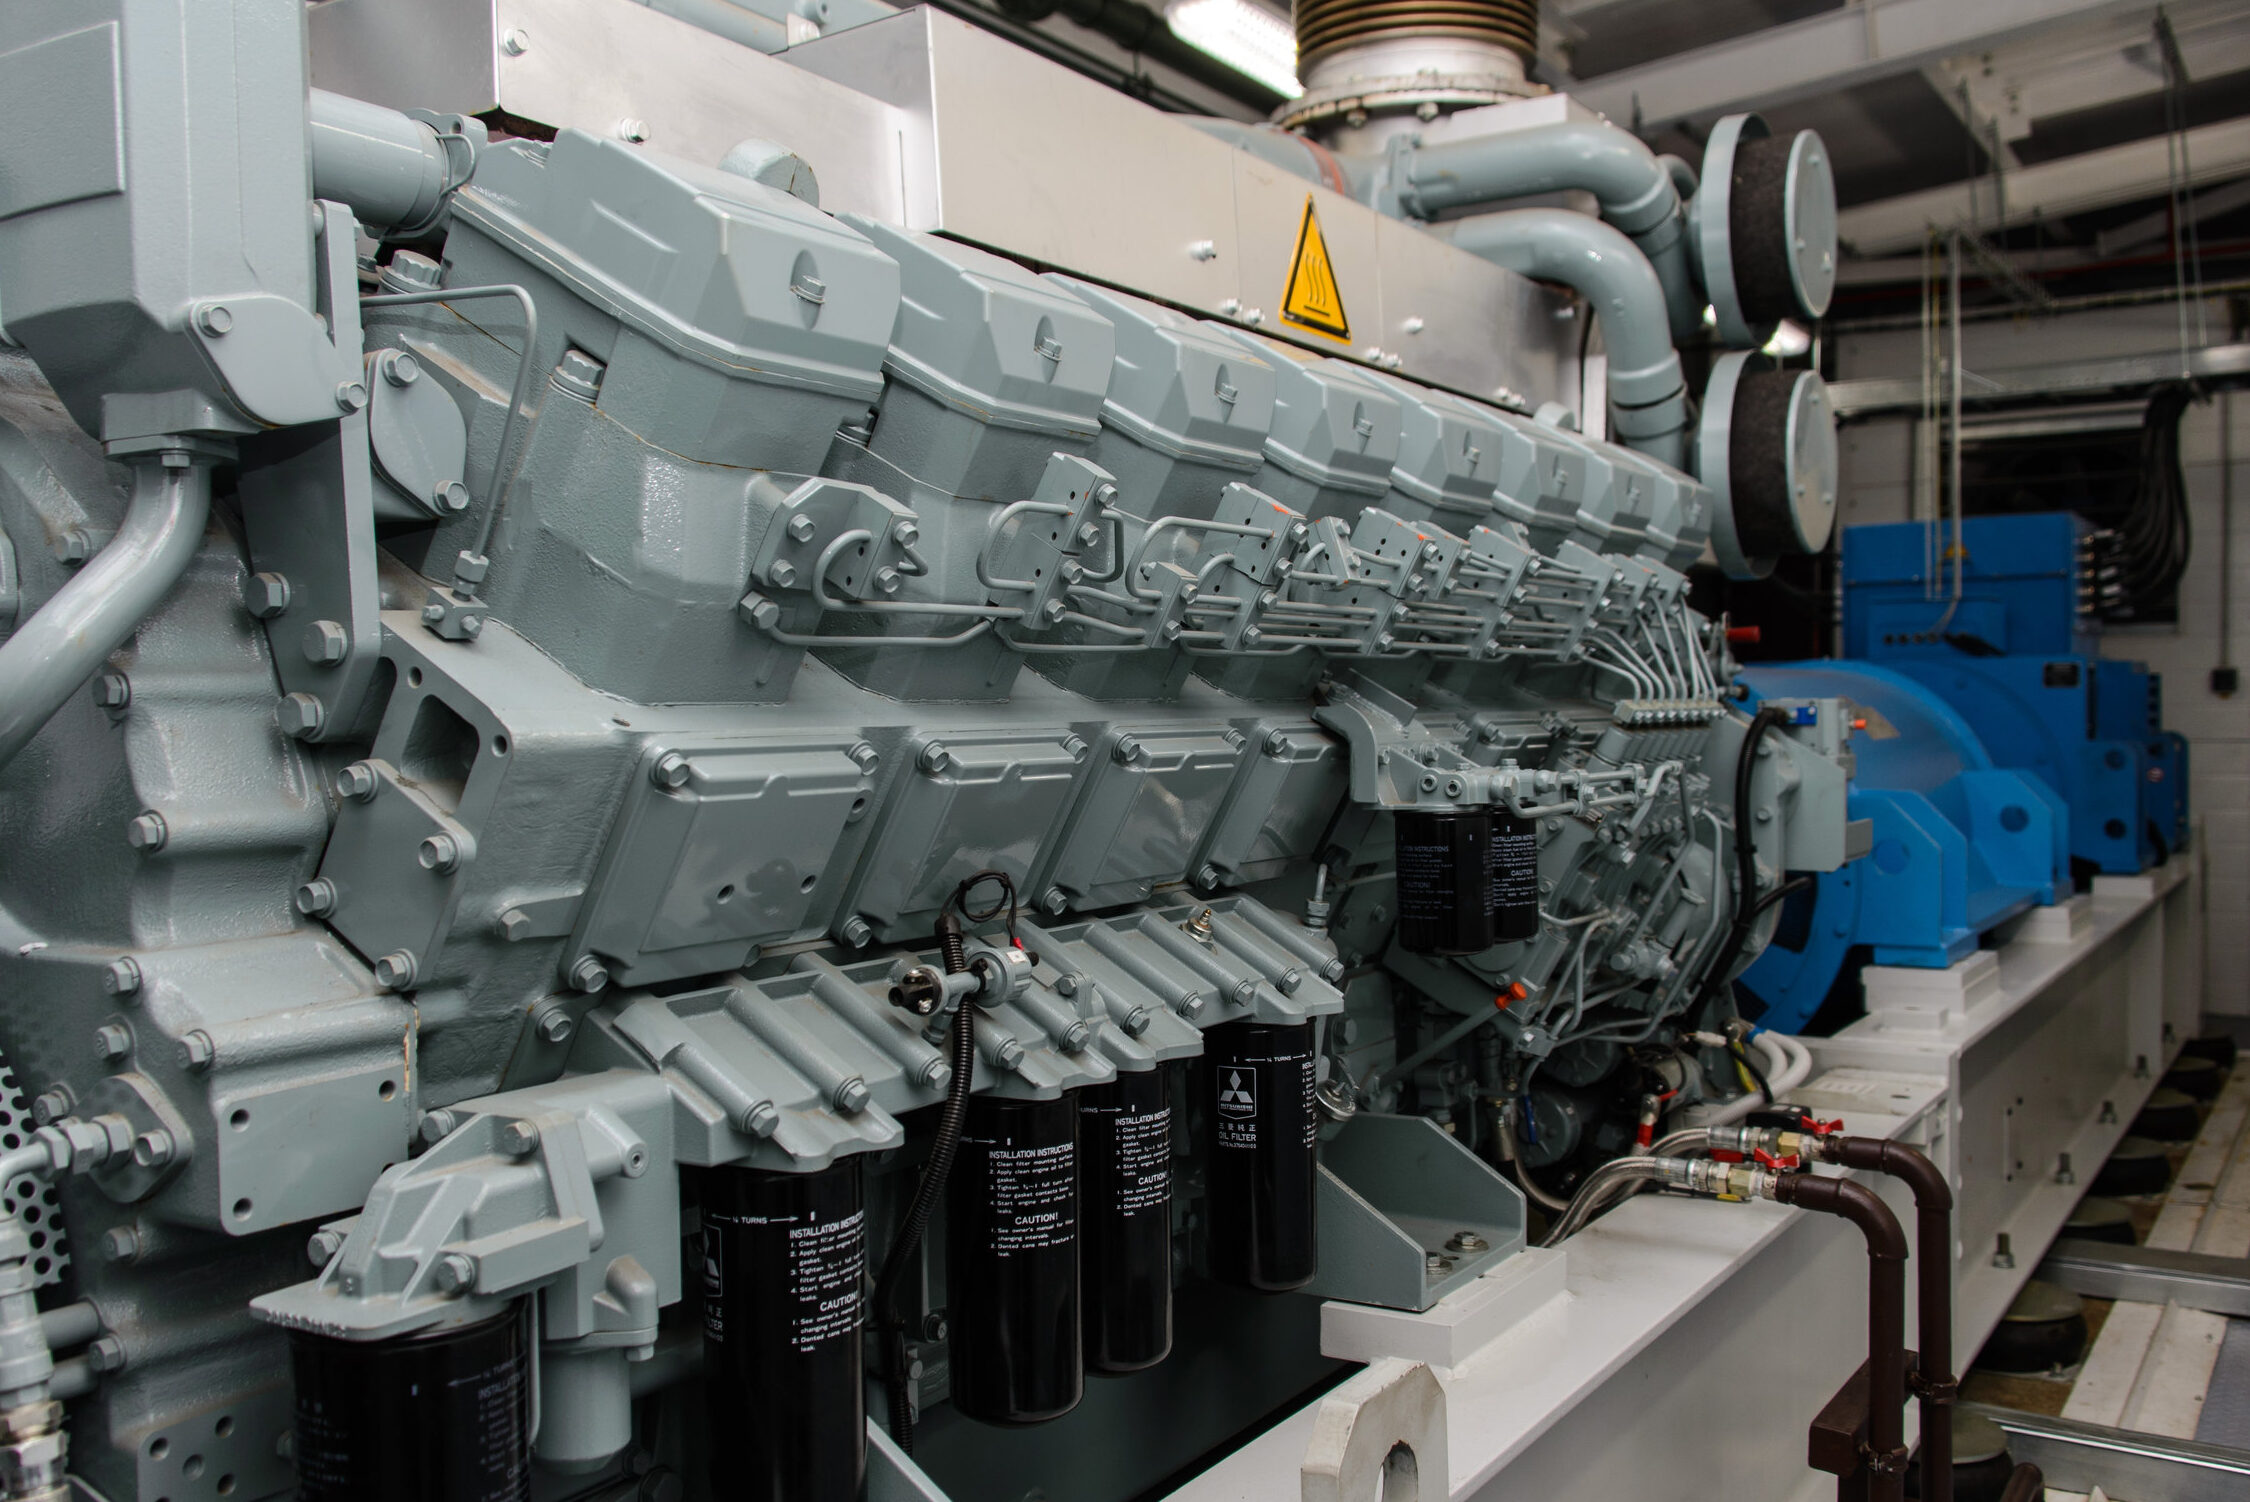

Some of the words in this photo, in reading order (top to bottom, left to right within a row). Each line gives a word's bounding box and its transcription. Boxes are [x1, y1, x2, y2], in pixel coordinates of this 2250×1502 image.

[1221, 1104, 1253, 1112] MITSUBISHI
[1115, 1114, 1153, 1126] INSTALLATION
[1232, 1133, 1257, 1141] FILTER
[989, 1150, 1036, 1159] INSTALLATION
[1037, 1142, 1074, 1156] INSTRUCTIONS
[1035, 1189, 1058, 1197] contacts
[741, 1216, 768, 1224] TURNS
[1015, 1212, 1058, 1225] CAUTION!
[790, 1222, 839, 1239] INSTALLATION
[1036, 1224, 1054, 1232] manual
[799, 1240, 817, 1248] Clean
[800, 1266, 824, 1275] Tighten
[819, 1272, 838, 1282] gasket
[820, 1290, 858, 1312] CAUTION!
[817, 1313, 839, 1322] owner's
[801, 1325, 828, 1334] changing
[801, 1334, 825, 1343] Dented
